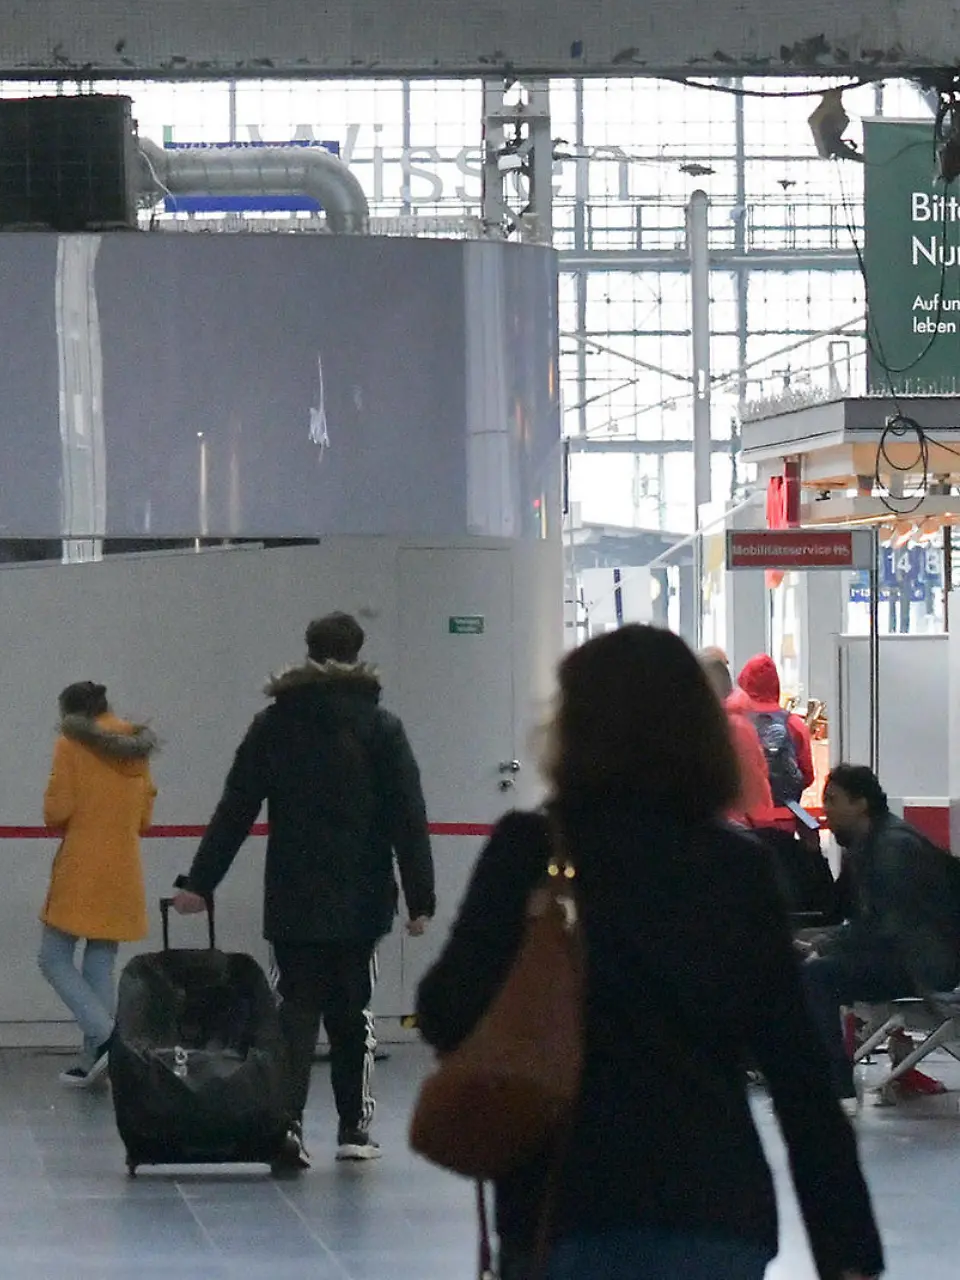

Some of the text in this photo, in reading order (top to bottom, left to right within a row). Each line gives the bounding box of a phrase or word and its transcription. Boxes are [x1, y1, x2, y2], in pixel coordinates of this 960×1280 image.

[911, 192, 960, 222] Bitt
[912, 293, 940, 311] Auf
[912, 316, 956, 333] leben
[887, 552, 912, 574] 14
